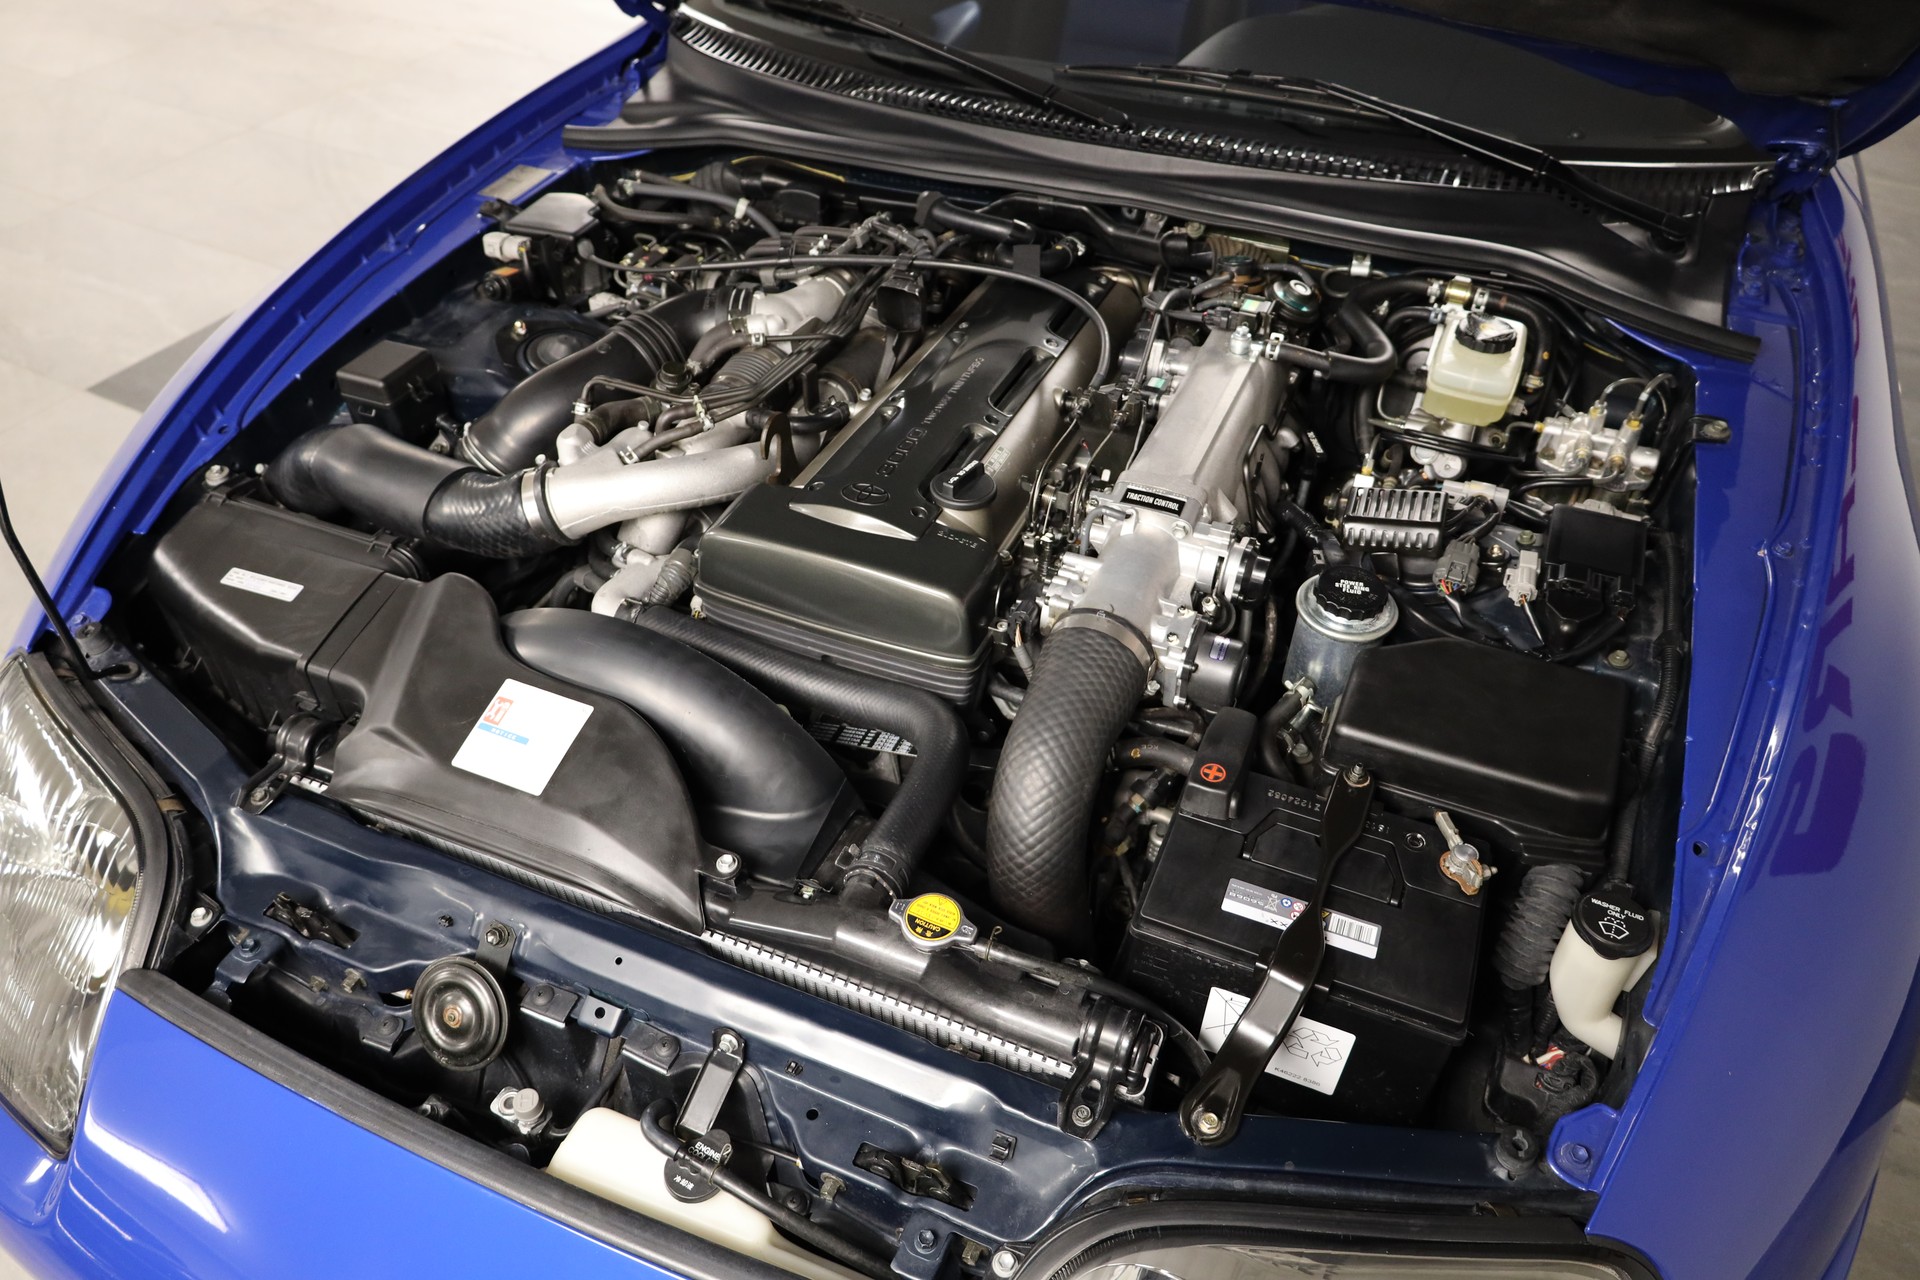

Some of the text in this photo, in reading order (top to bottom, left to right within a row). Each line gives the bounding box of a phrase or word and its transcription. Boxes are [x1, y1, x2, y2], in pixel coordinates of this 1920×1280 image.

[1126, 492, 1179, 511] TRACTION CONTROL
[1340, 579, 1364, 587] POWER
[1342, 587, 1362, 595] FLUID
[1591, 897, 1644, 921] WASHER FLUID
[1607, 909, 1626, 920] ONLY
[915, 918, 941, 932] CAUTION
[694, 1141, 721, 1161] ENGINE
